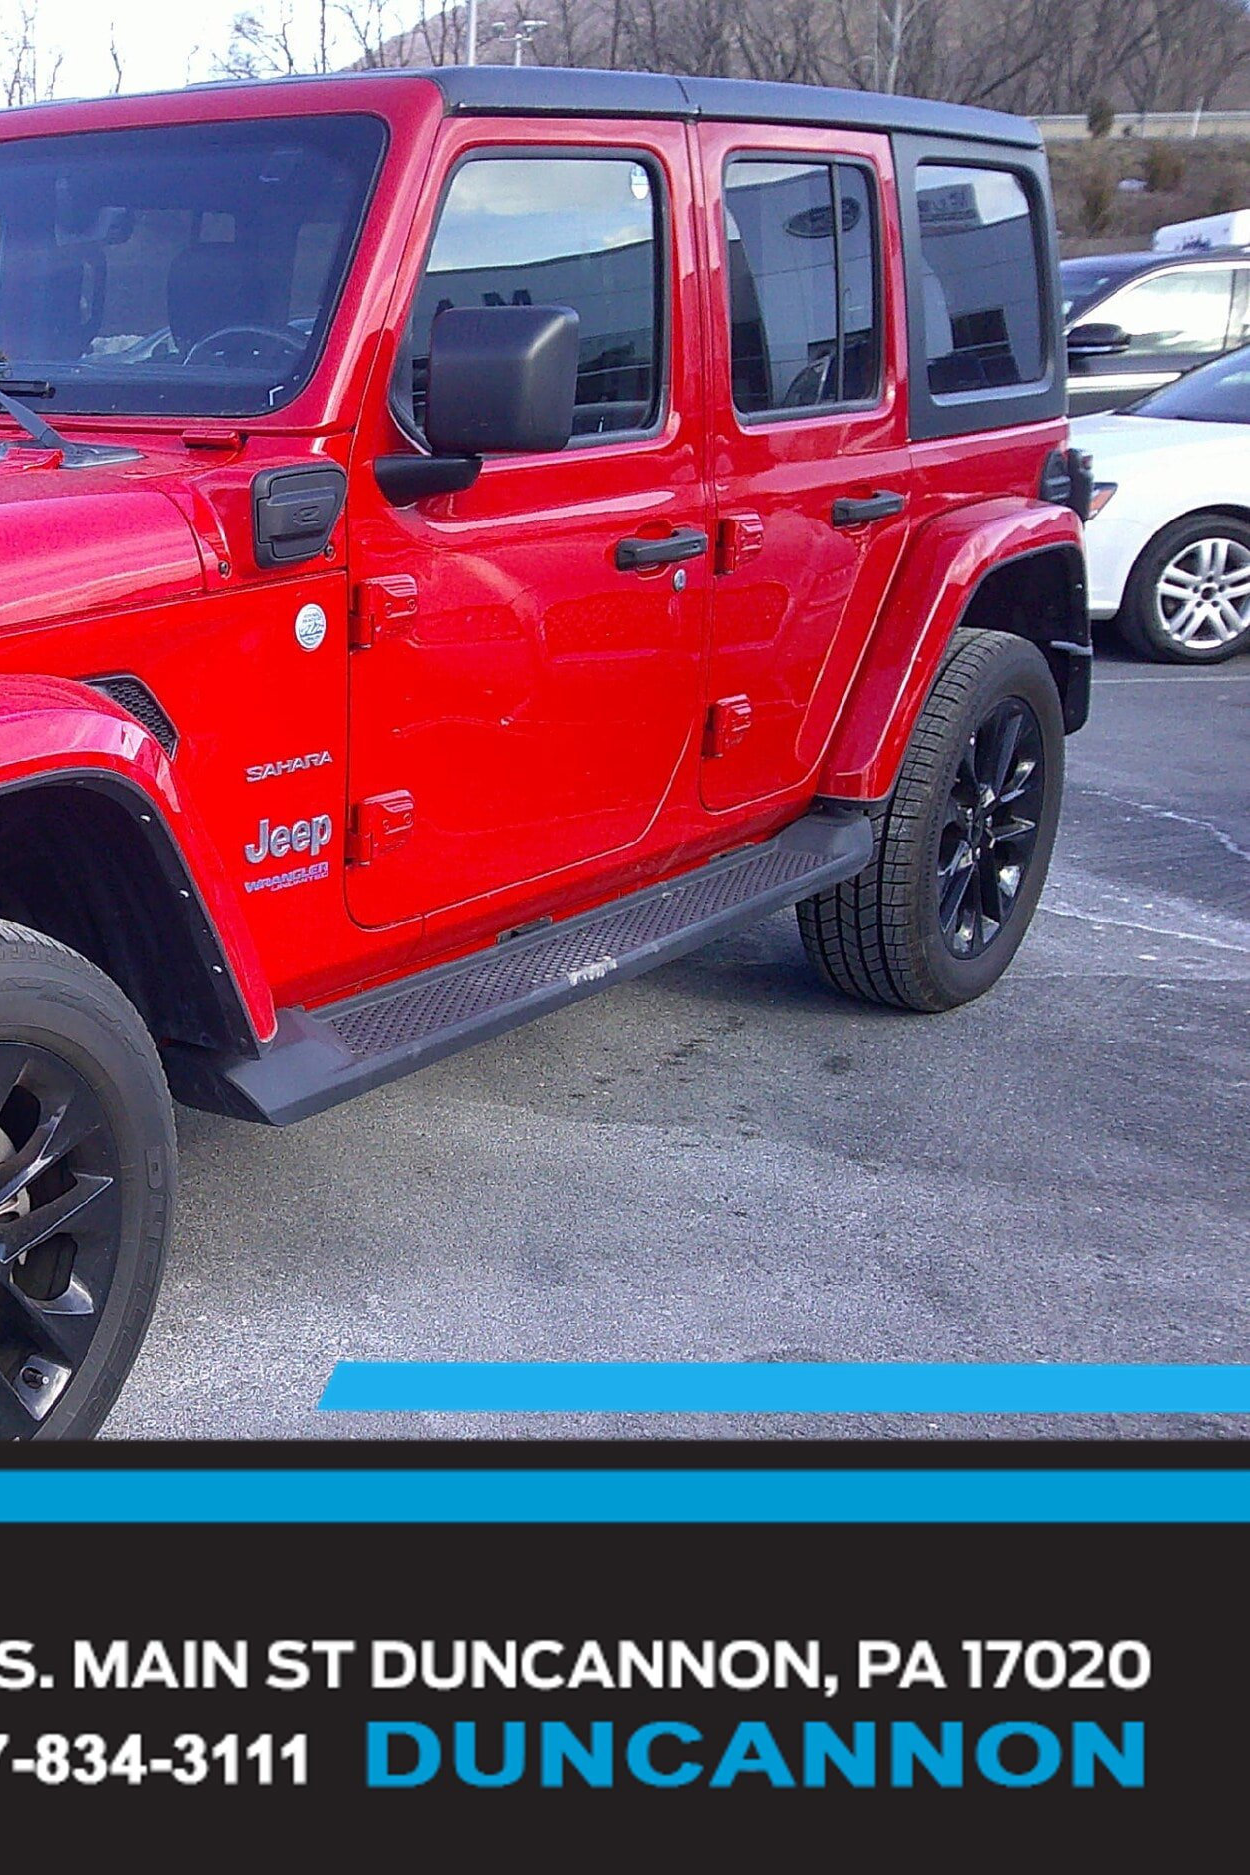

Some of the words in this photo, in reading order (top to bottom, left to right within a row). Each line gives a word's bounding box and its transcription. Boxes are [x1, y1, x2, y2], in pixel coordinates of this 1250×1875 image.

[245, 751, 333, 783] SAHARA
[244, 814, 332, 863] Jeep
[244, 862, 329, 893] WRANGLER
